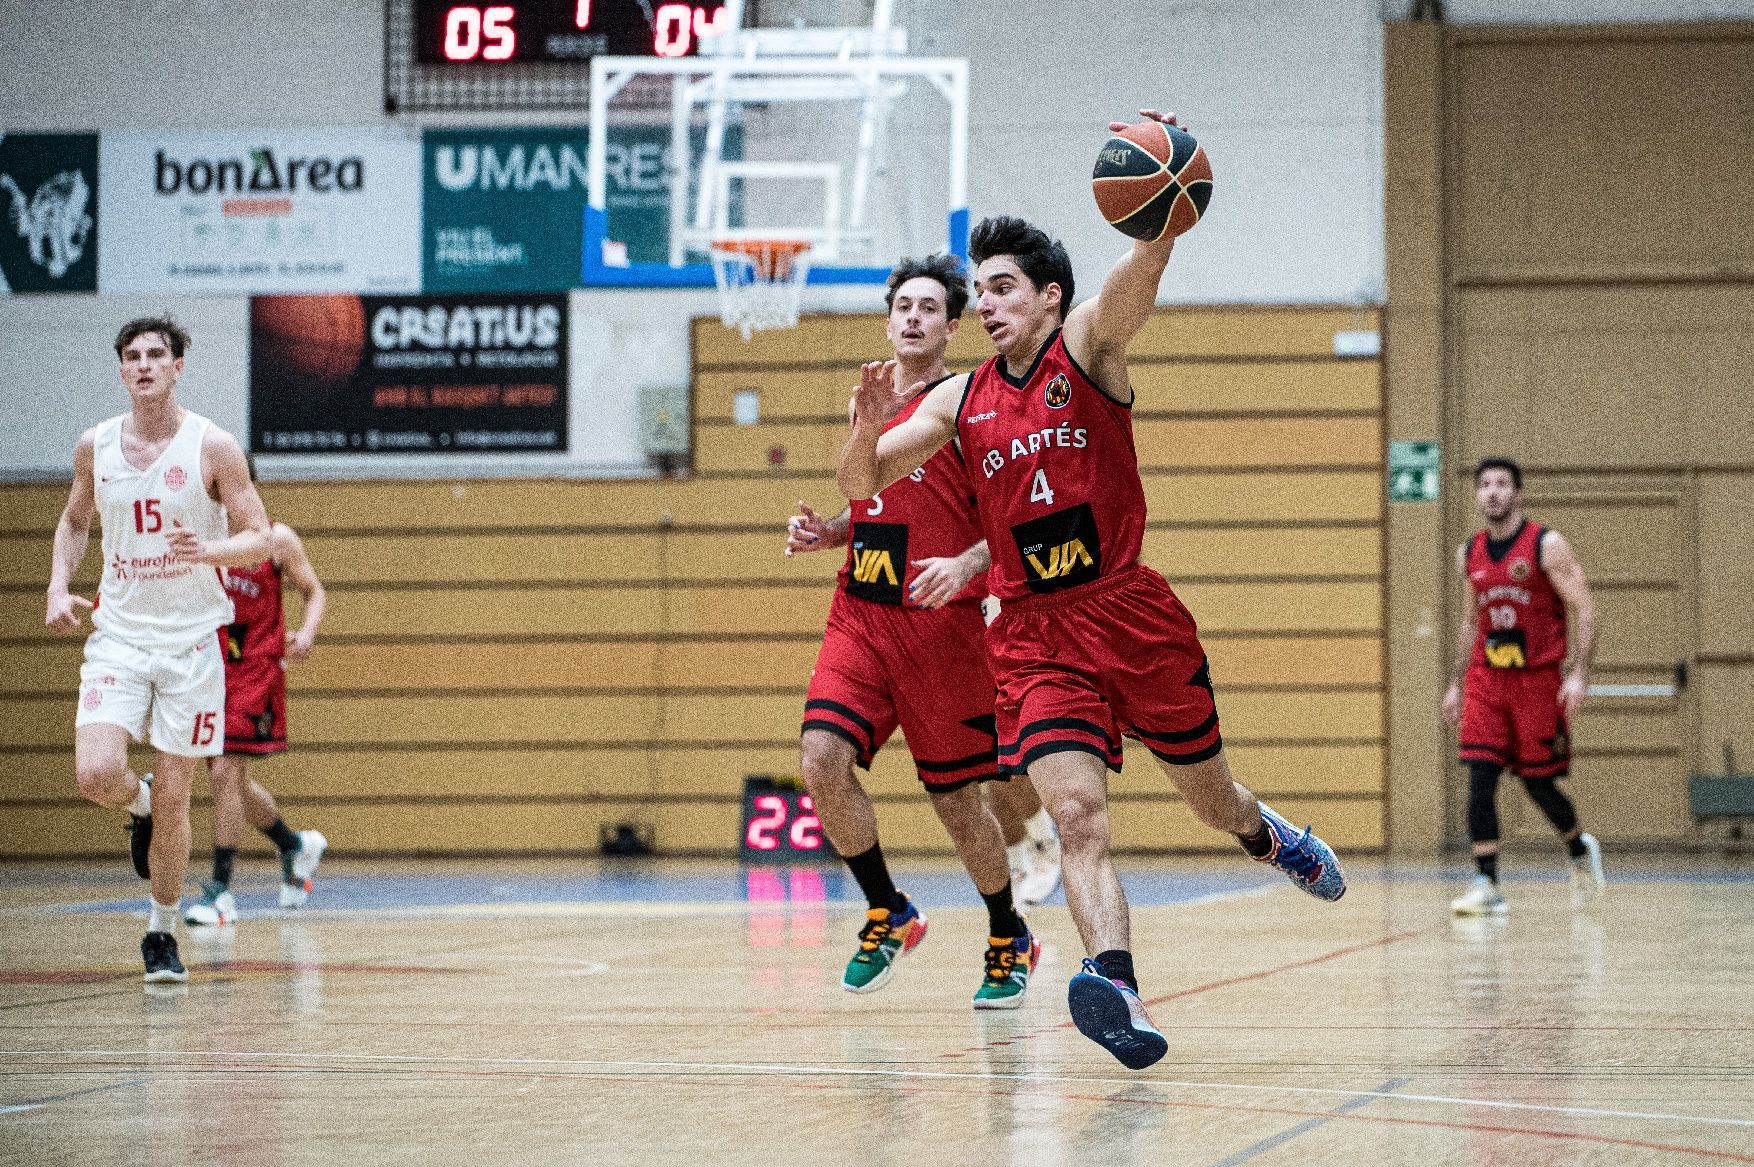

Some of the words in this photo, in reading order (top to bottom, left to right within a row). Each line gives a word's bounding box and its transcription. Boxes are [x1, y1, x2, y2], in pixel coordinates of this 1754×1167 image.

[444, 6, 516, 60] 05
[371, 305, 560, 348] CREATIUS
[981, 449, 1005, 479] CB
[1010, 421, 1088, 460] ARTÉS
[1030, 468, 1055, 505] 4
[132, 498, 162, 535] 15
[1488, 605, 1517, 630] 10
[191, 711, 218, 747] 15
[746, 793, 823, 851] 22
